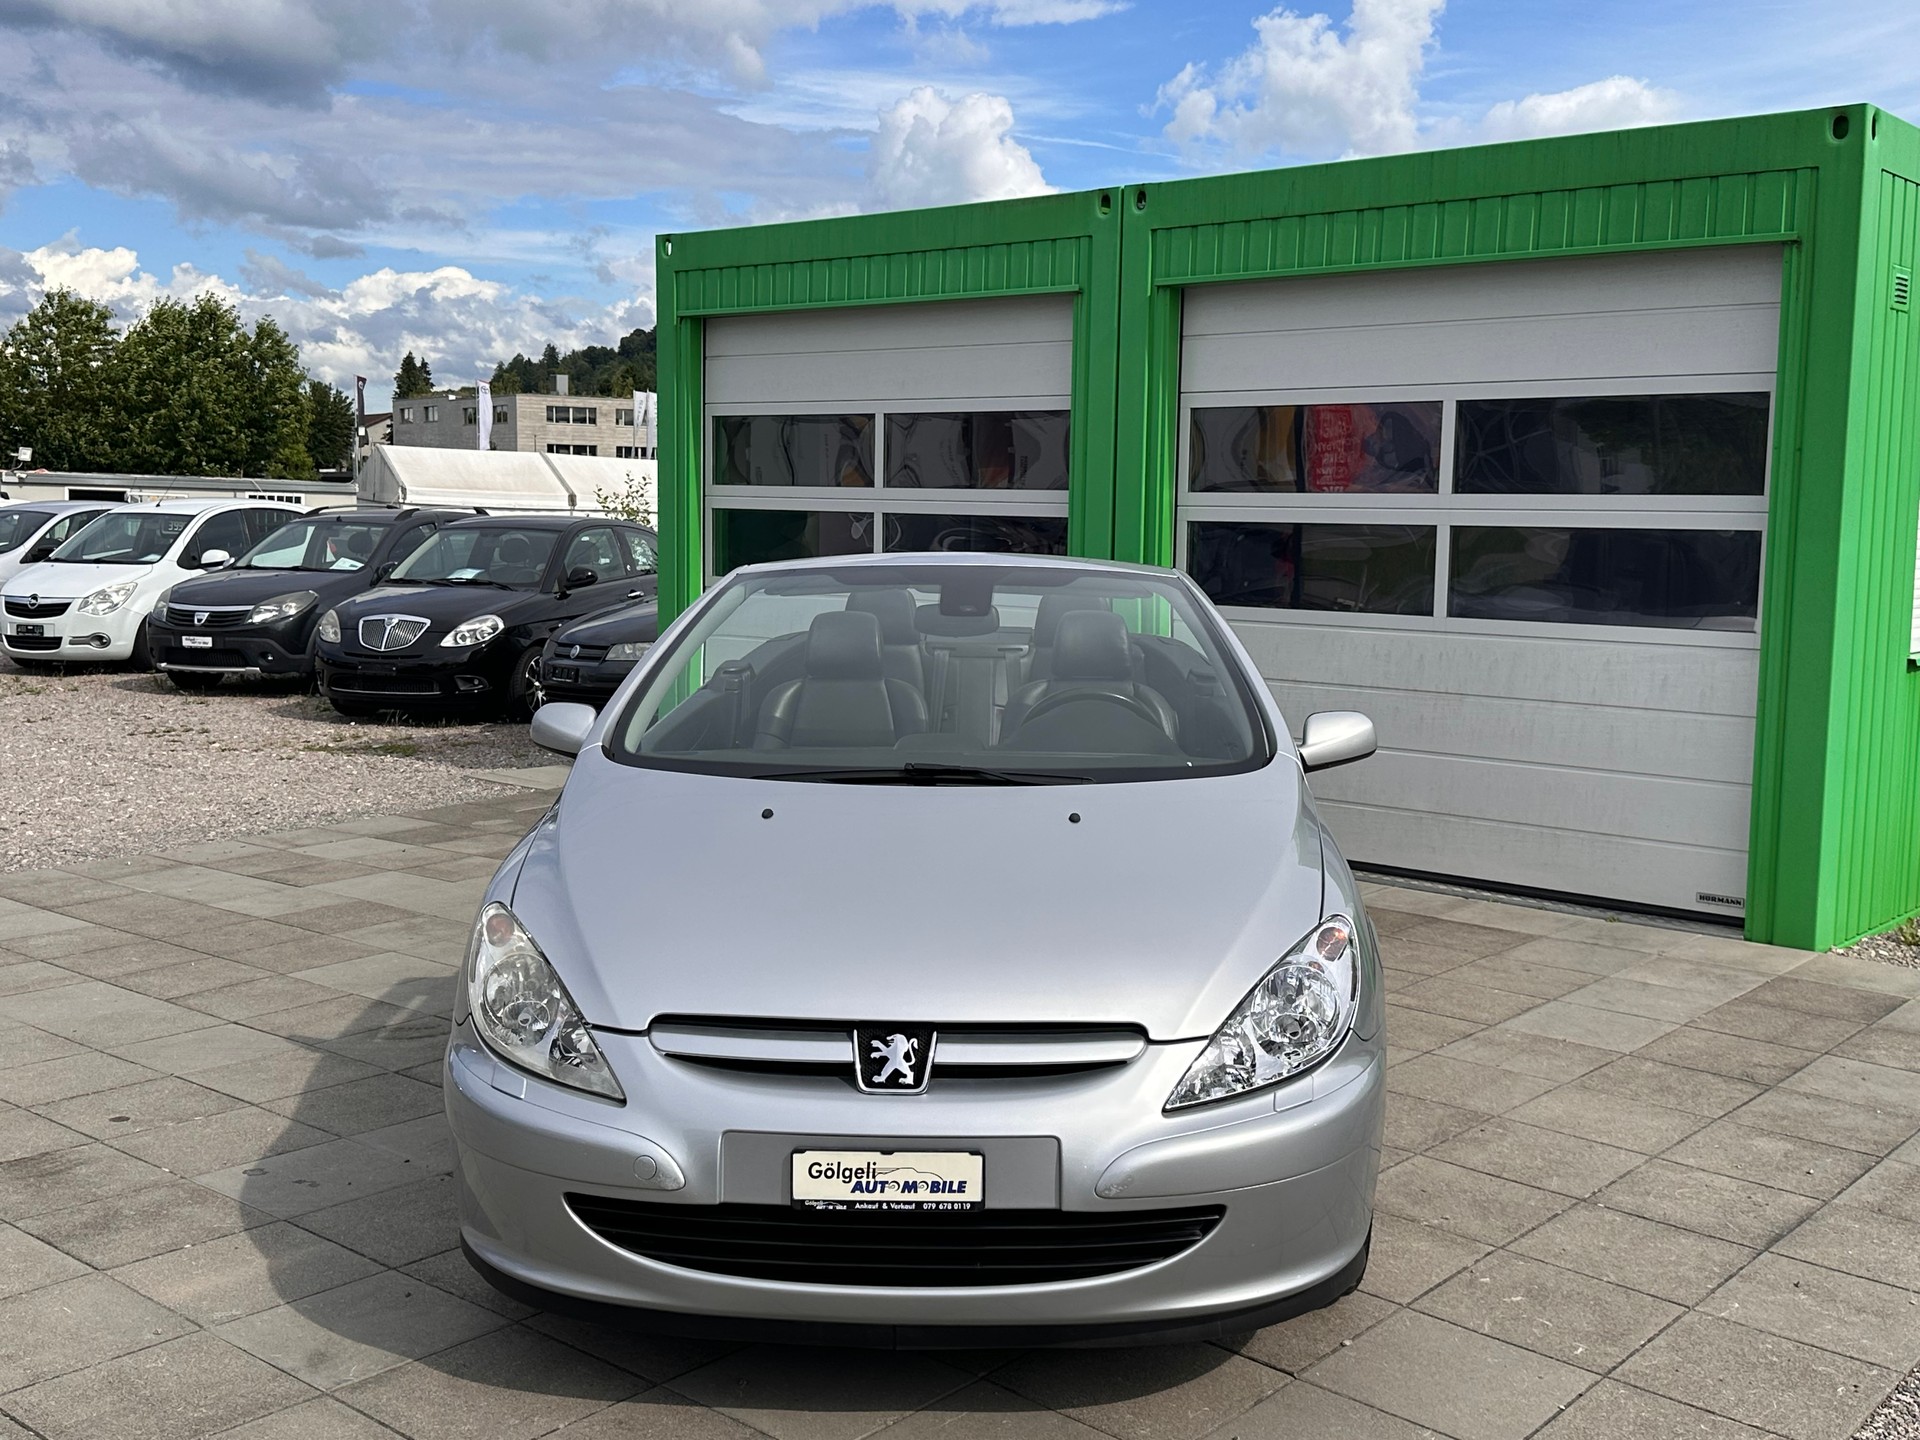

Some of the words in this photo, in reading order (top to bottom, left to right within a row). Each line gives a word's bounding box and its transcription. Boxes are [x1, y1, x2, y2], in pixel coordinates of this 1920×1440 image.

[807, 1161, 877, 1184] Gölgeli
[850, 1180, 968, 1194] AUTOMOBILE
[854, 1202, 879, 1210] Ankauf
[882, 1202, 888, 1210] &
[890, 1202, 916, 1210] Verkauf
[922, 1202, 937, 1210] 079
[938, 1202, 952, 1210] 678
[953, 1202, 971, 1210] 0119
